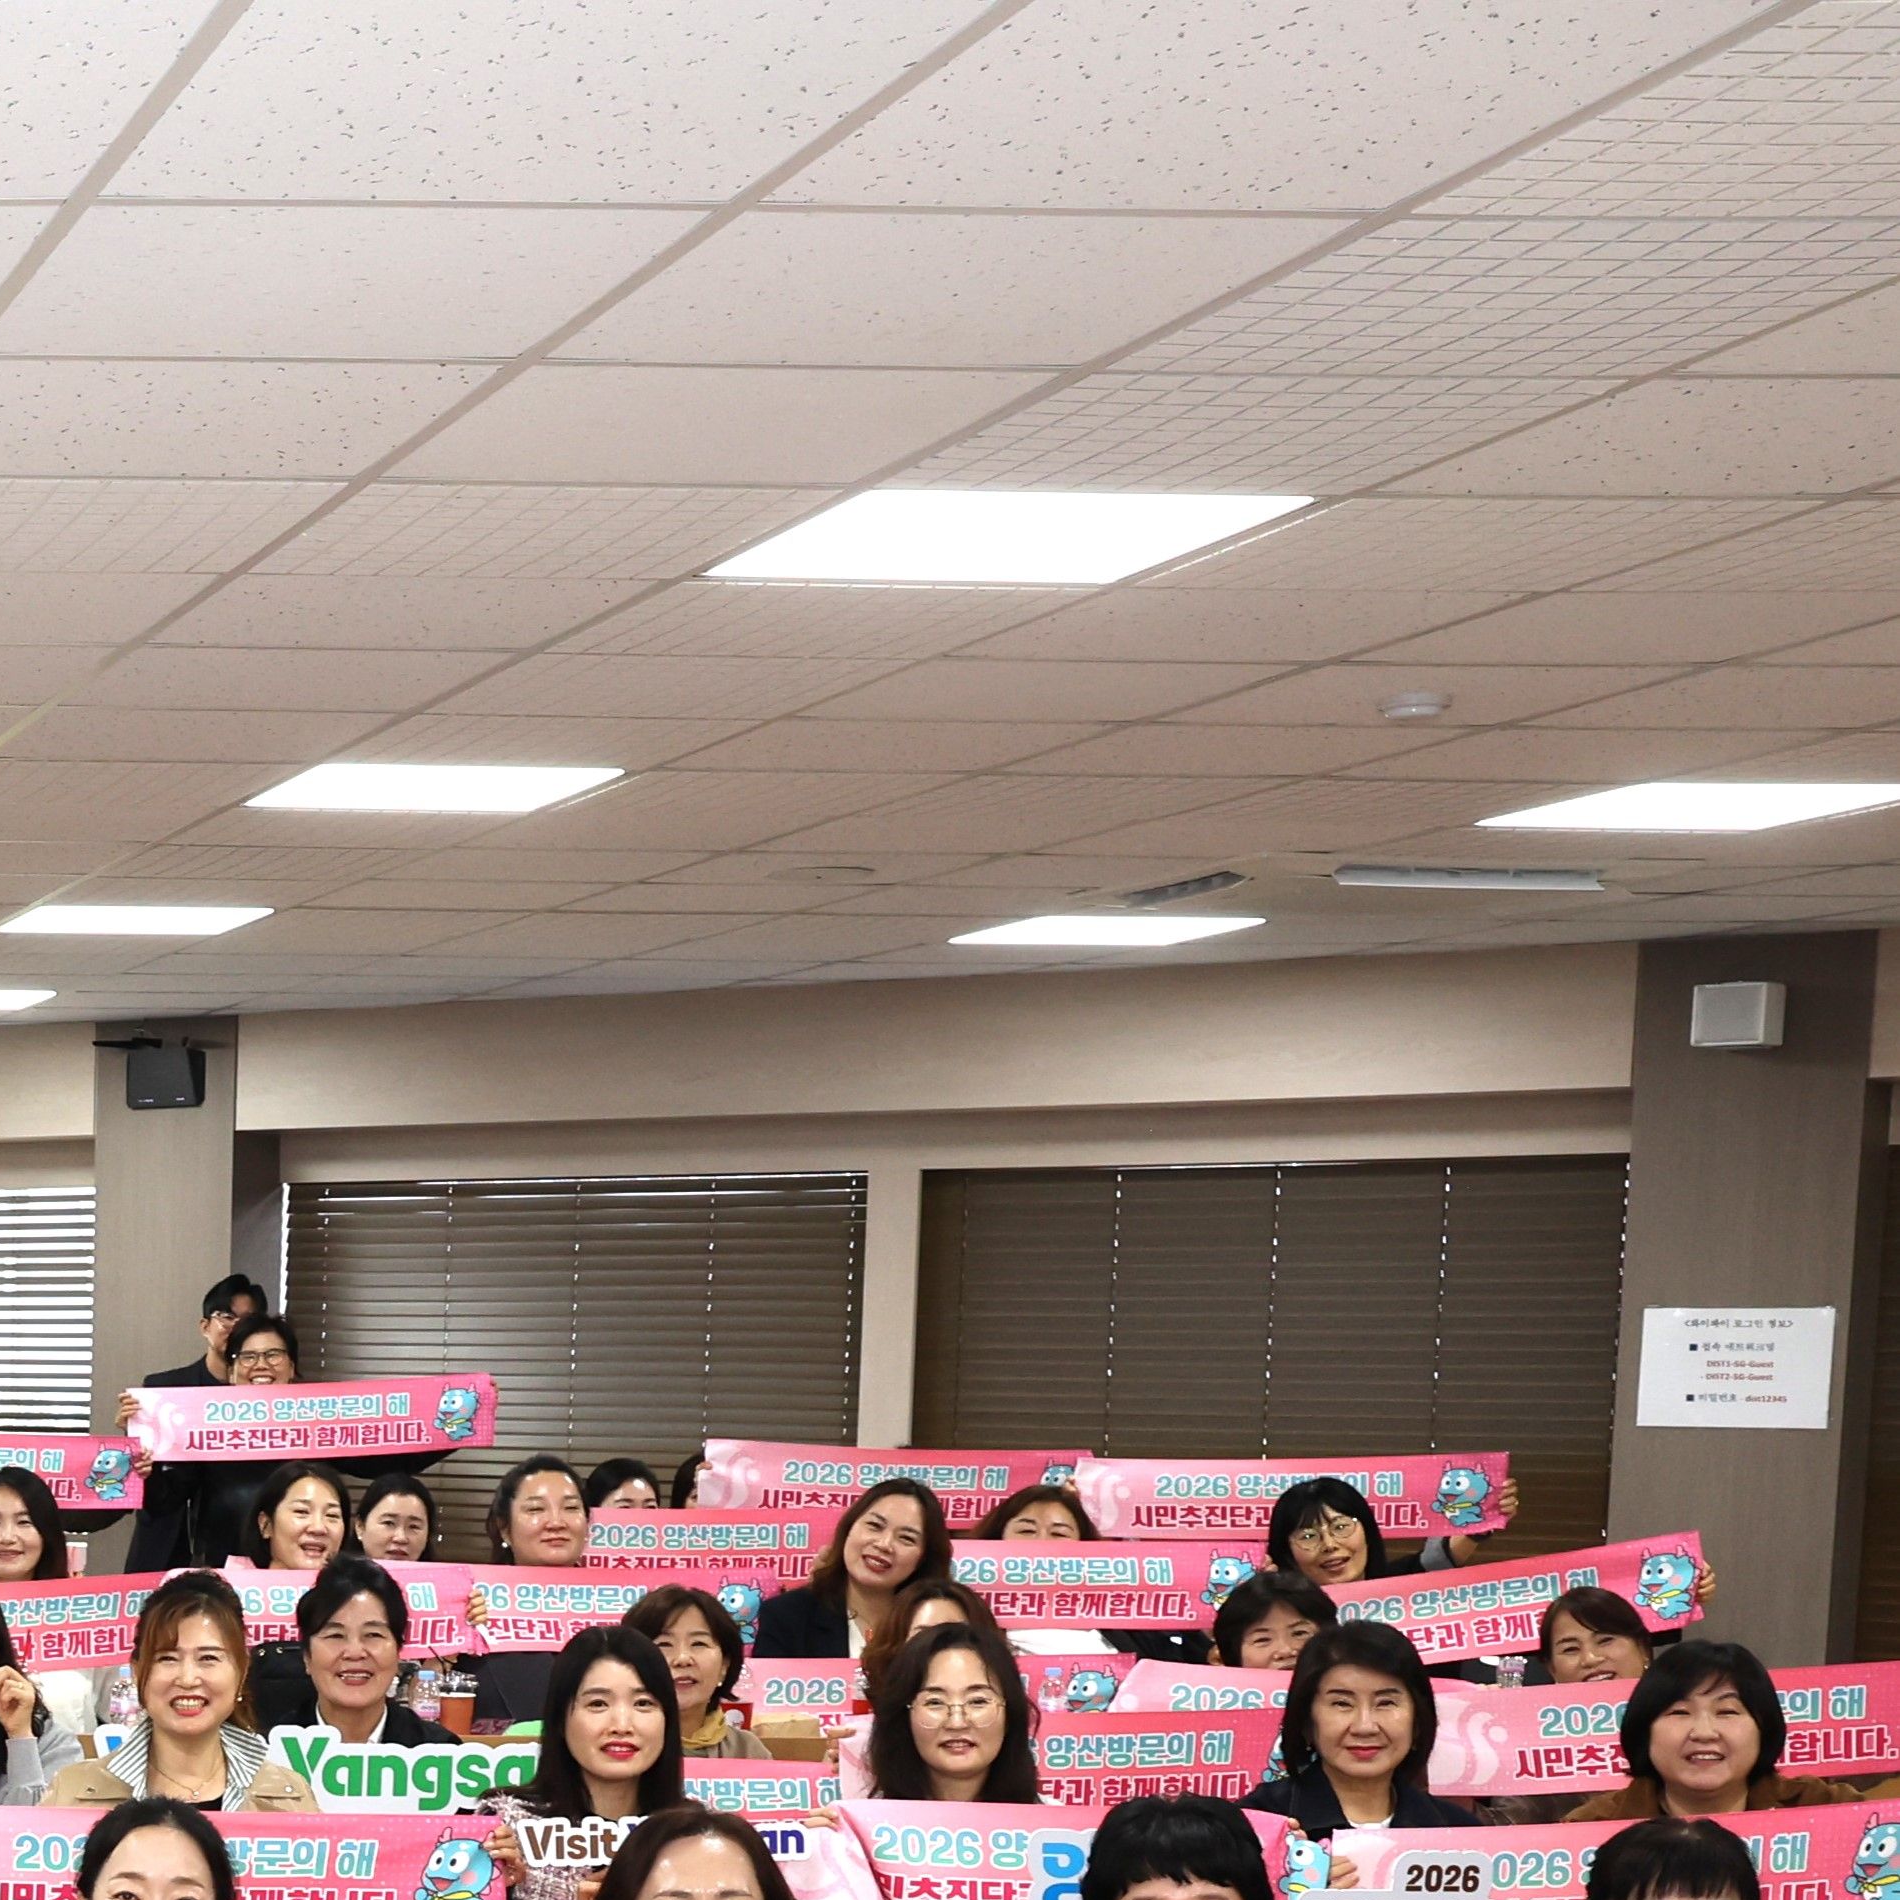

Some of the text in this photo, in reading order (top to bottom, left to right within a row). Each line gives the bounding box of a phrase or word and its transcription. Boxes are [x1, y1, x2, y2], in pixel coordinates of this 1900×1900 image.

[206, 1393, 408, 1422] 2026 양산방문의 해
[185, 1422, 431, 1450] 시민추진단과 함께합니다.
[41, 1449, 64, 1471] 해
[784, 1462, 1010, 1490] 2026 해
[1156, 1470, 1402, 1498] 2026 해
[591, 1523, 808, 1550] 2026 양산방문의 해
[1005, 1557, 1172, 1585] 양산방문의 해
[409, 1584, 435, 1610] 해
[1055, 1592, 1196, 1619] 함께합니다.
[1410, 1576, 1558, 1619] 양산방문의
[766, 1677, 845, 1704] 2026
[1831, 1686, 1865, 1718] 해
[1046, 1731, 1233, 1768] 양산방문의 해
[281, 1736, 538, 1811] Yangsa
[525, 1825, 618, 1859] Visit
[874, 1828, 980, 1863] 2026
[1771, 1834, 1809, 1872] 해
[336, 1840, 375, 1878] 해
[1406, 1866, 1479, 1893] 2026
